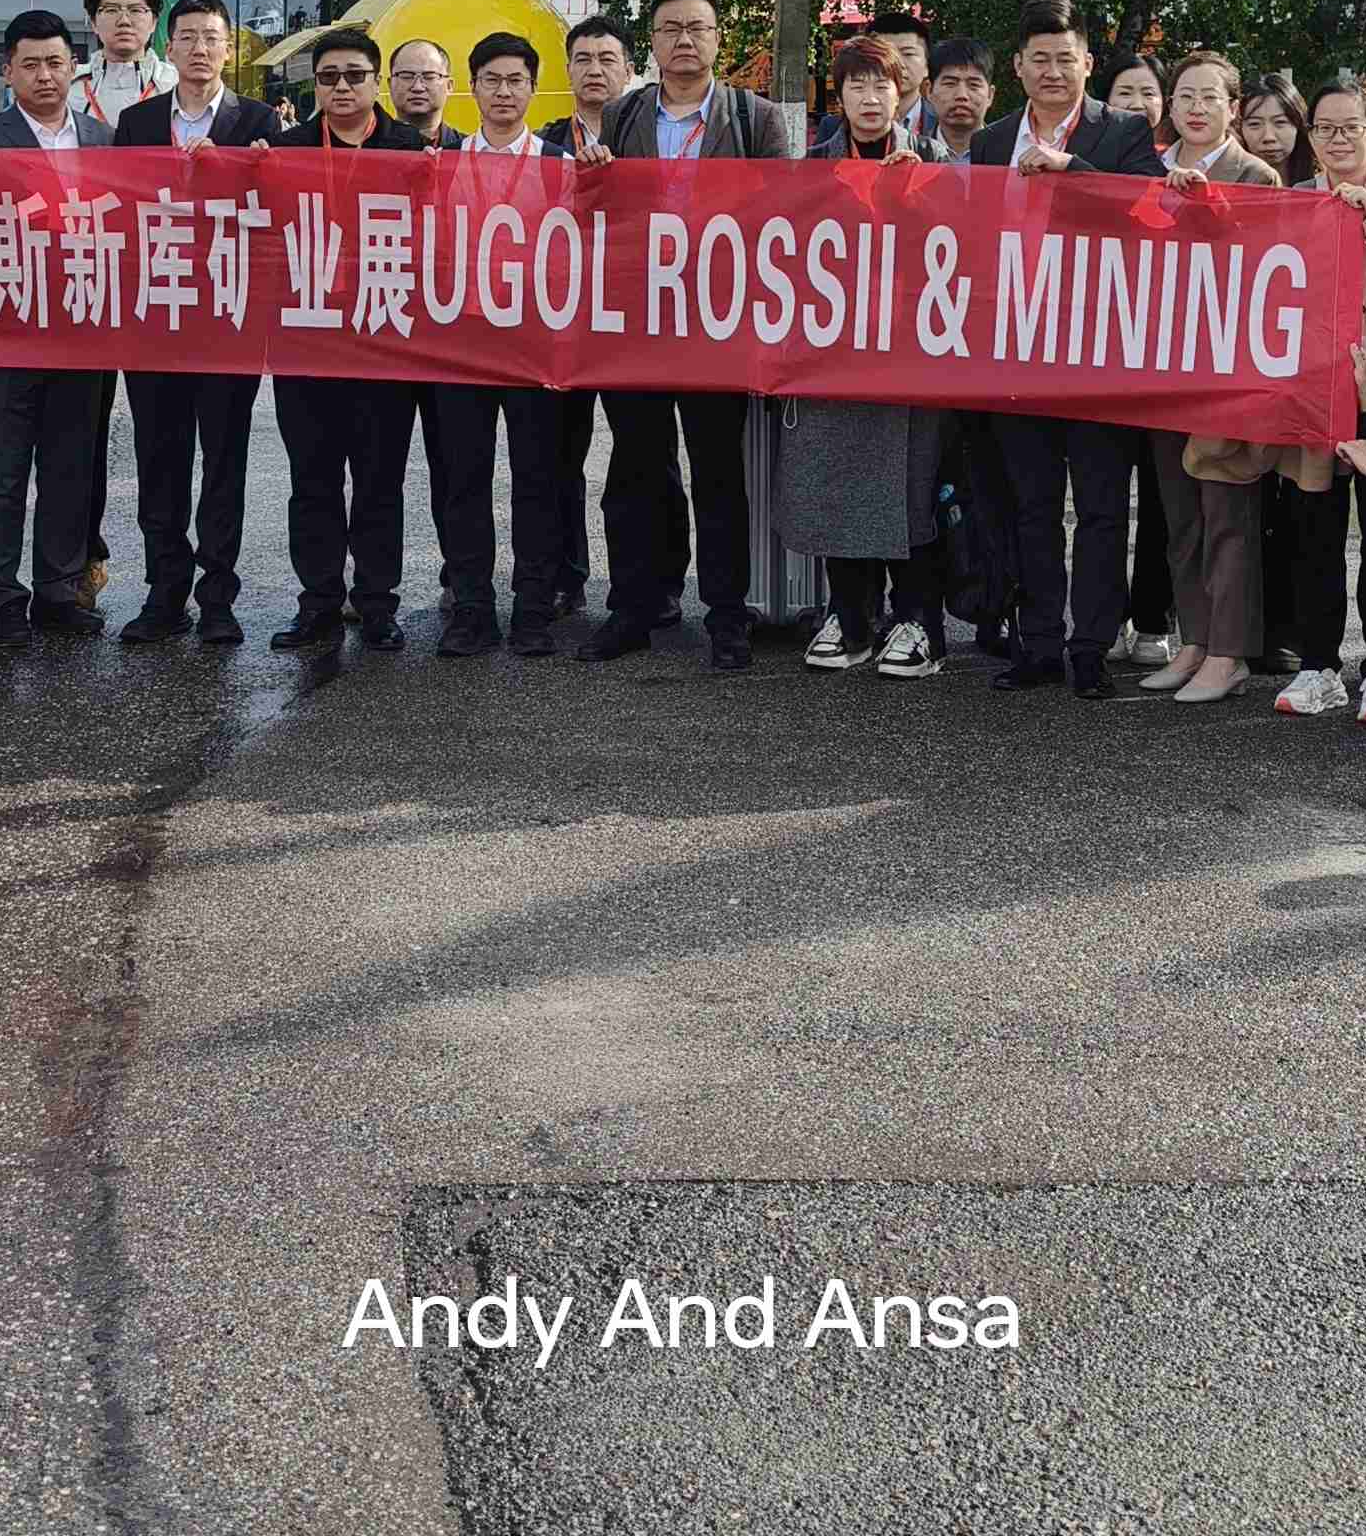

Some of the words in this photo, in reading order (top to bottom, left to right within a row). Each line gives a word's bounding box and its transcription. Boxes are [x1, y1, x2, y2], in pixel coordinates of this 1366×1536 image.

[647, 212, 897, 352] ROSSII
[916, 224, 972, 358] &
[993, 231, 1308, 378] MINING
